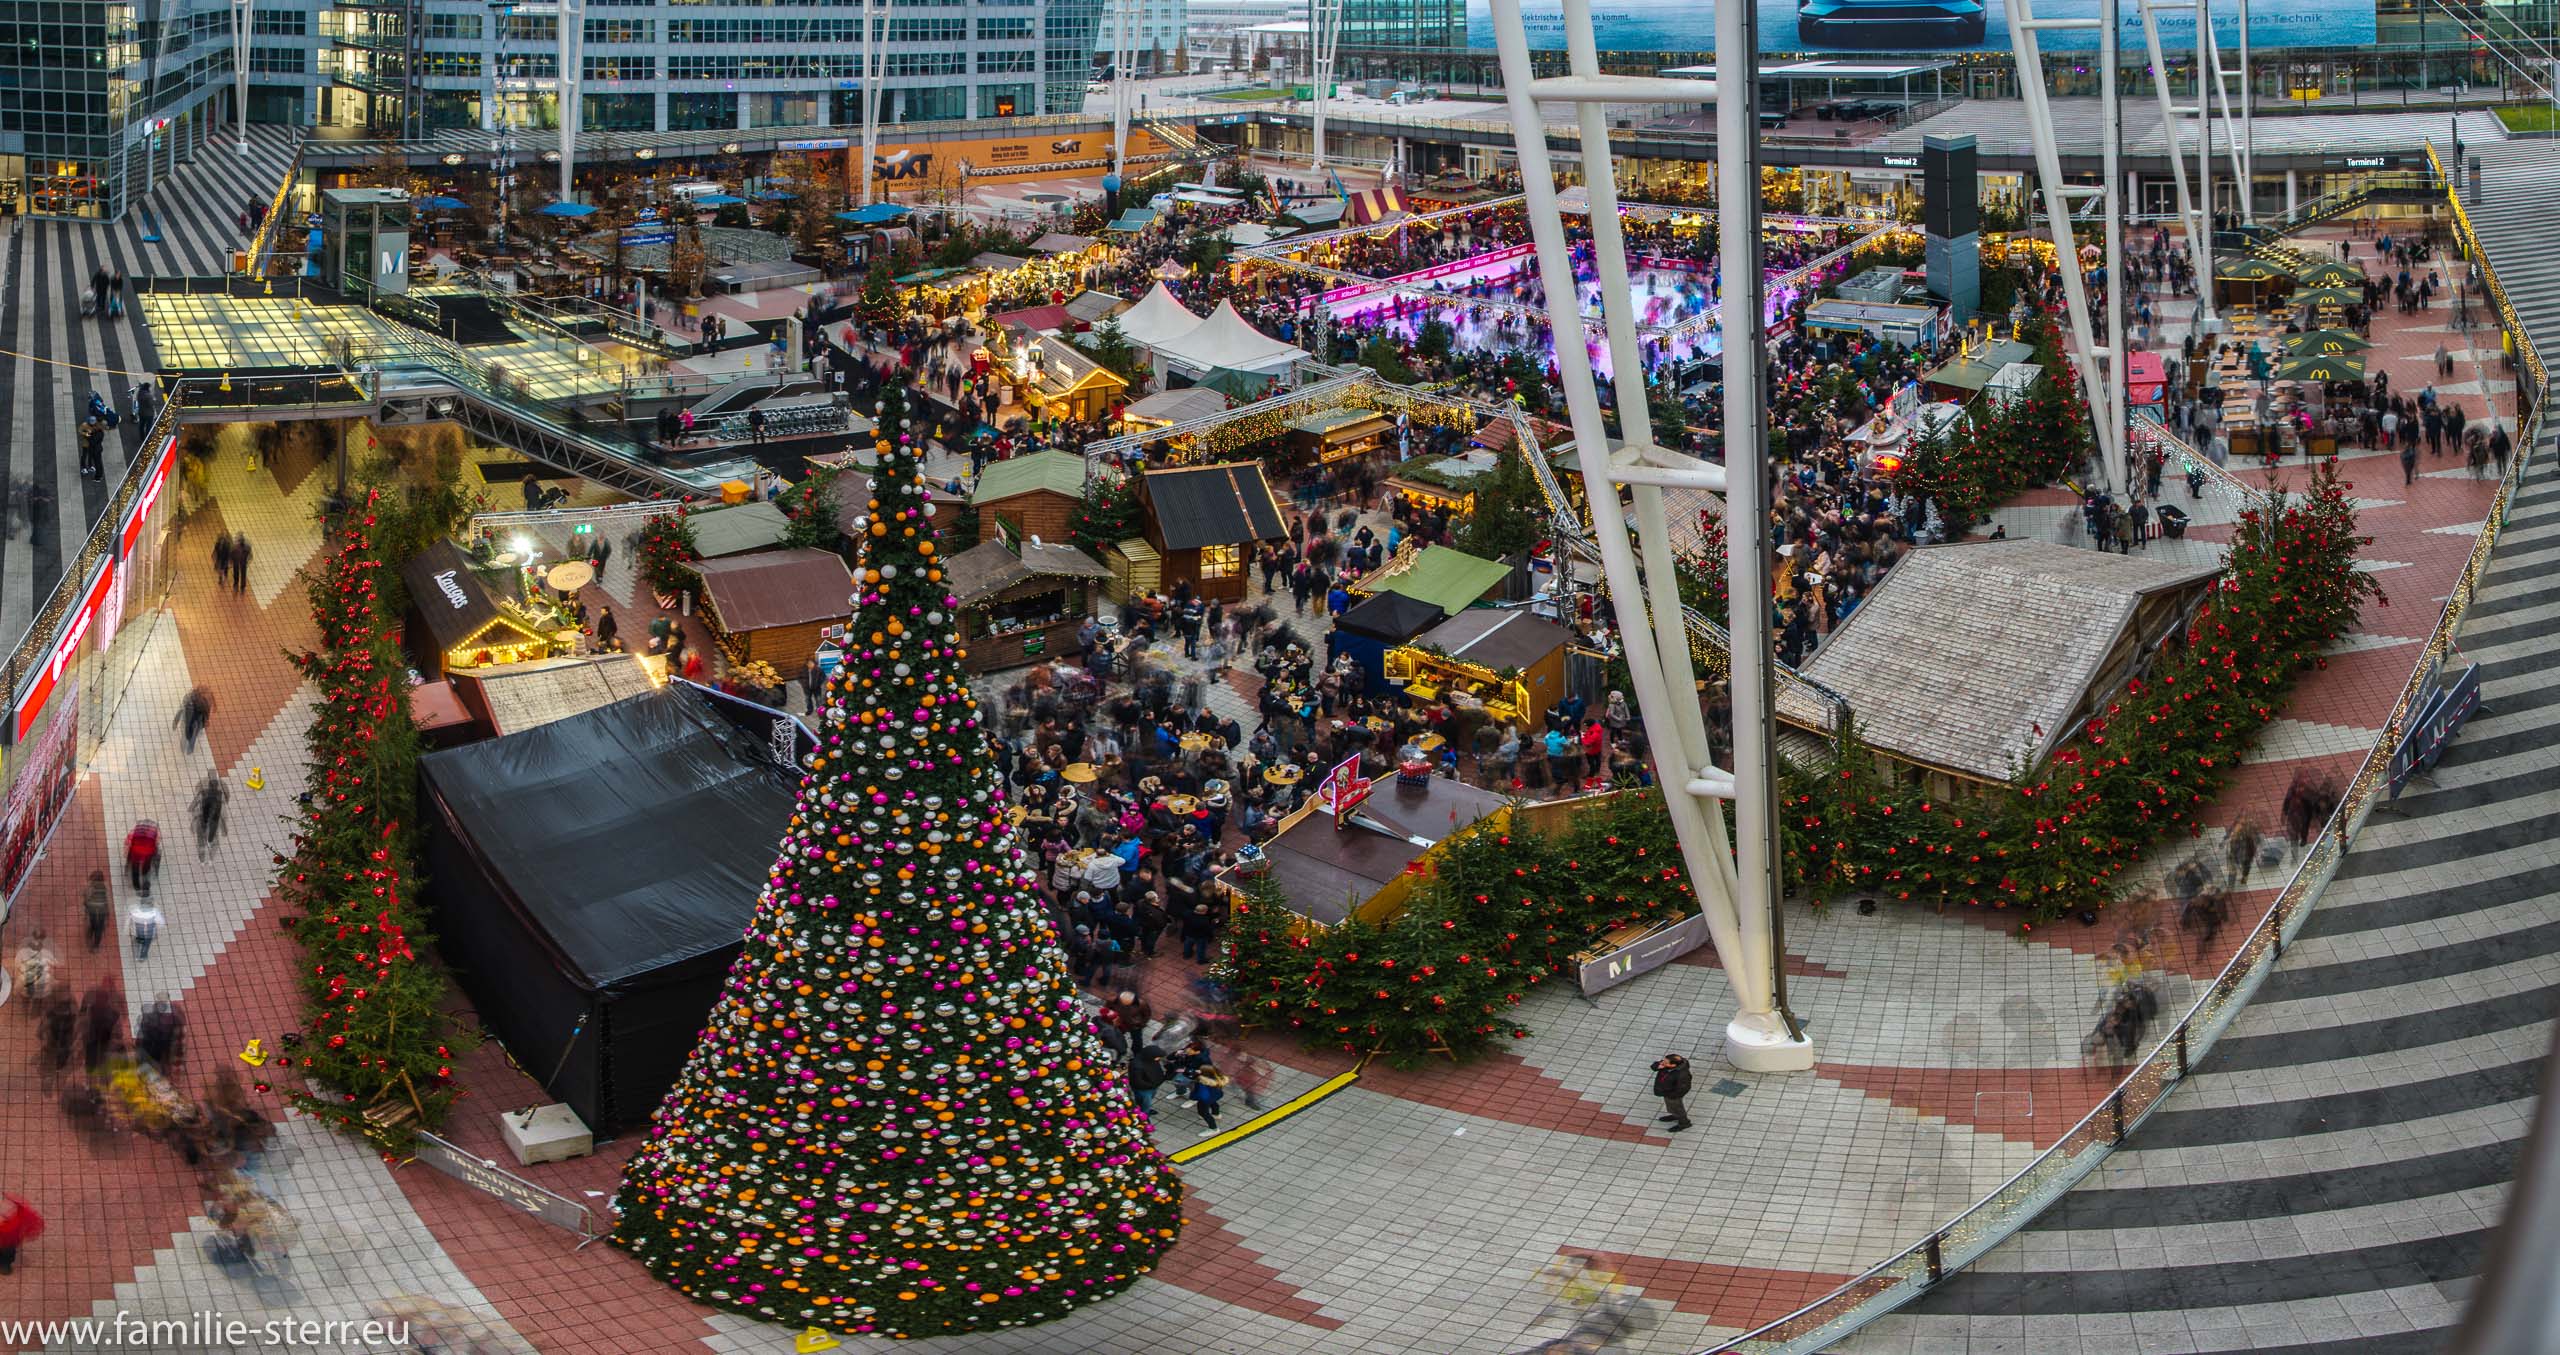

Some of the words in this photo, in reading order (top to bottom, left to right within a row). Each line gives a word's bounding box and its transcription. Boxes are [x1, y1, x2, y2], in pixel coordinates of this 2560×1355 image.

[2230, 15, 2268, 25] drch
[2272, 13, 2323, 25] Technik
[1883, 156, 1912, 166] Terminal
[1912, 158, 1918, 166] 2
[2346, 157, 2379, 166] Terminal
[2379, 157, 2385, 166] 2
[433, 570, 469, 610] Langos
[444, 1148, 529, 1198] Terminal
